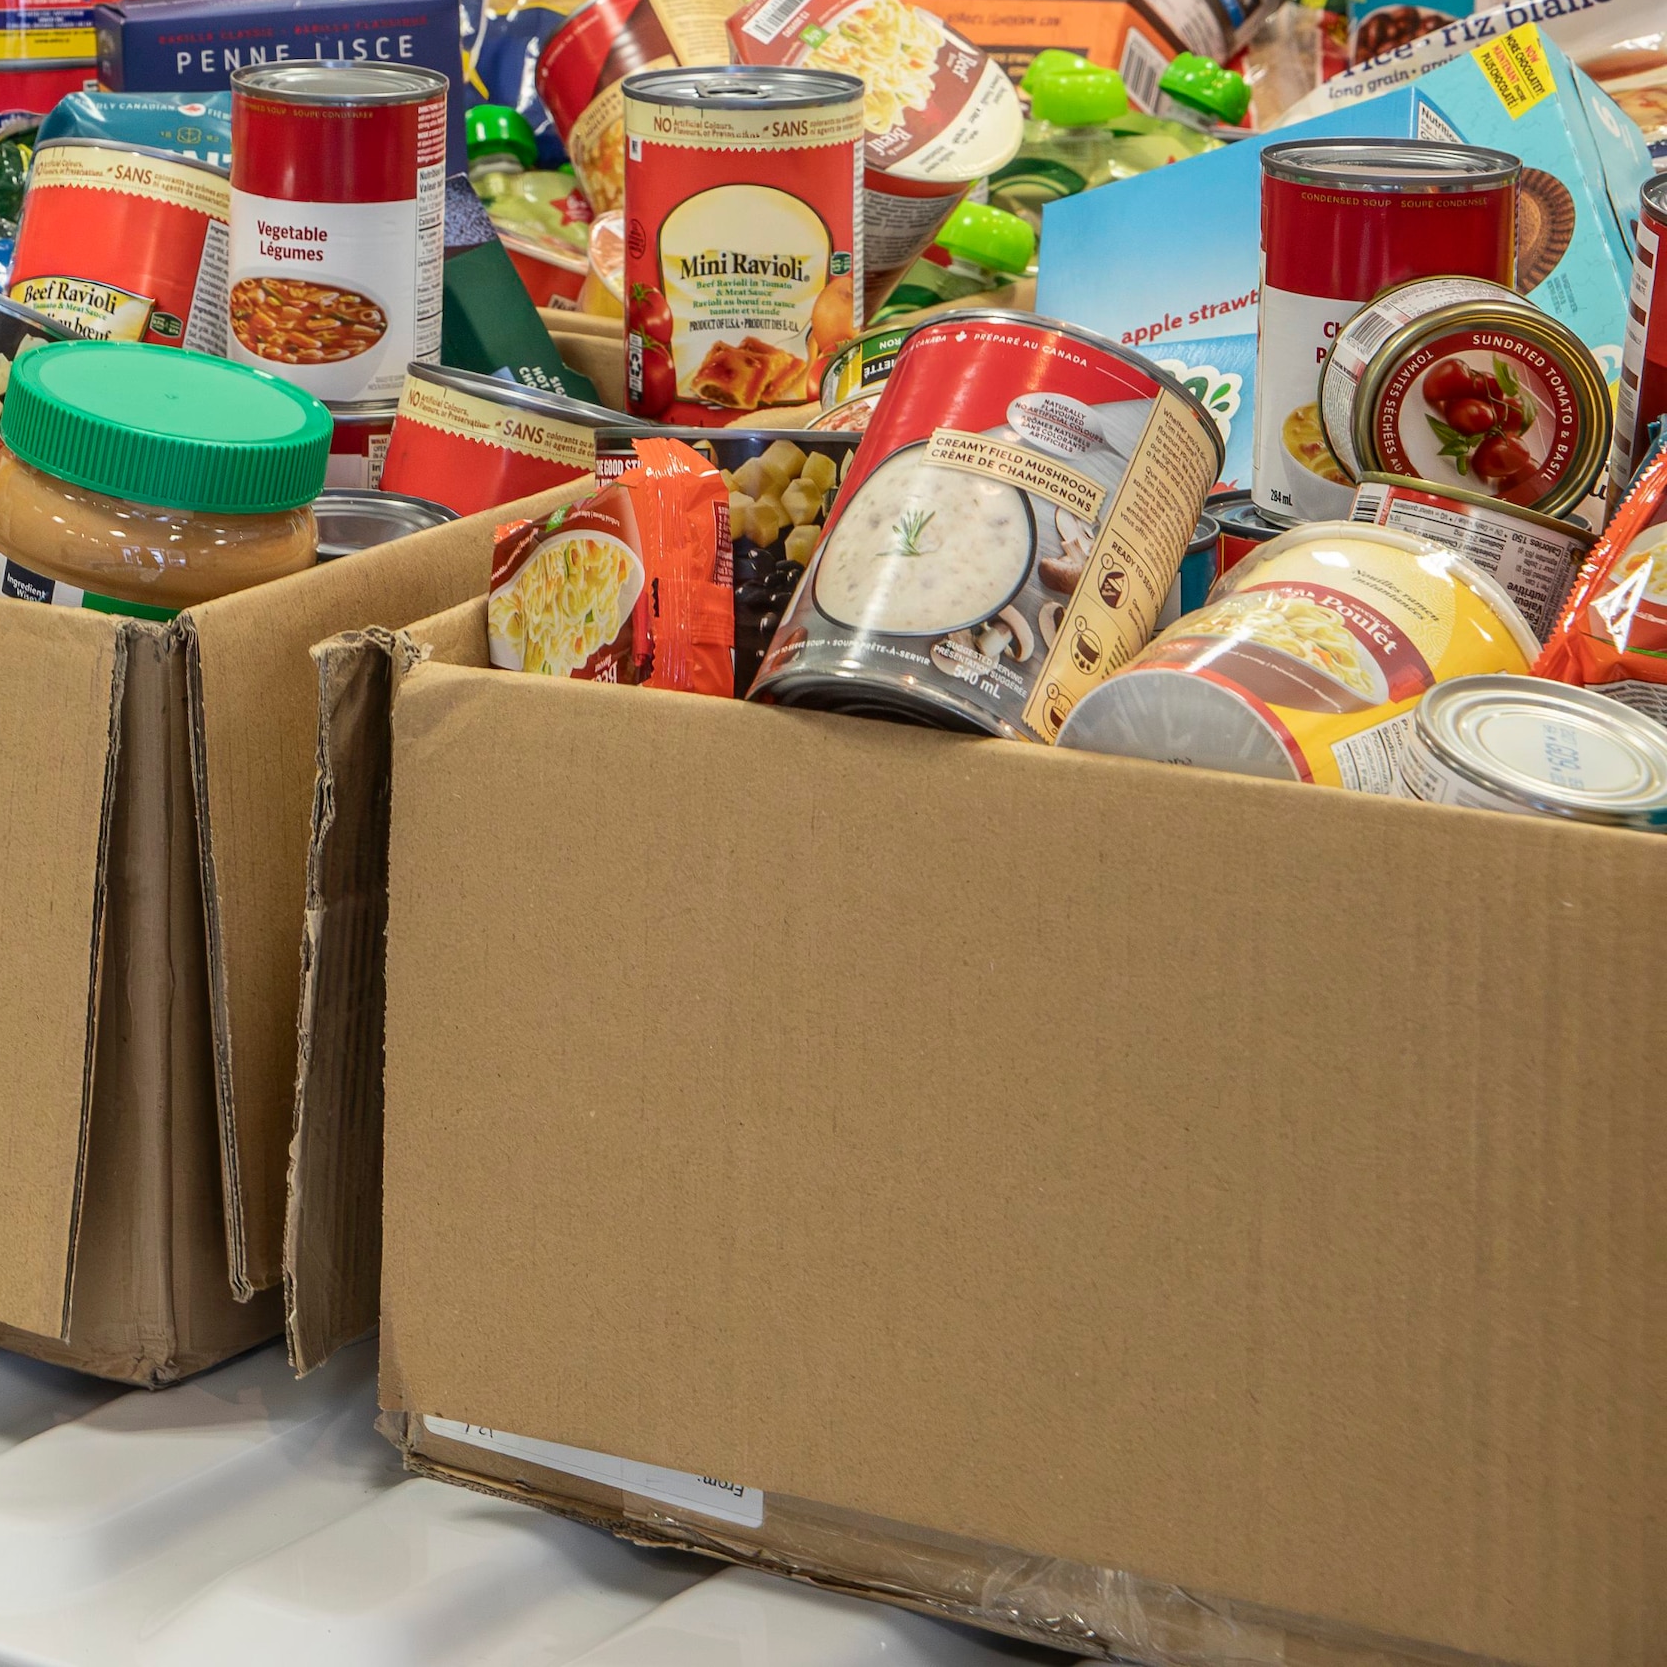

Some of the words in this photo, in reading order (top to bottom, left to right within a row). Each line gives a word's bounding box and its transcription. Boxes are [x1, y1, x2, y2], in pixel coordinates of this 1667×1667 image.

[1443, 16, 1496, 48] riz
[176, 44, 290, 75] PENNE
[314, 34, 414, 63] LISCE
[1481, 52, 1496, 70] PLUS
[1492, 44, 1520, 85] MAINTENANT
[1506, 33, 1521, 54] MORE
[1515, 52, 1546, 97] CHOCOLATEY!
[1525, 44, 1540, 64] NOW
[1328, 83, 1364, 100] long
[1366, 70, 1410, 97] grain
[653, 116, 672, 133] NO
[673, 119, 703, 129] Artificial
[772, 119, 809, 137] SANS
[115, 164, 153, 186] SANS
[1301, 191, 1360, 206] CONDENSED
[1362, 197, 1392, 208] SOUP
[1400, 198, 1434, 209] SOUPE
[257, 219, 329, 243] Vegetable
[260, 240, 325, 263] Légumes
[680, 252, 727, 280] Mini
[731, 252, 804, 282] Ravioli
[23, 279, 55, 304] Beef
[56, 280, 118, 315] Ravioli
[696, 280, 715, 290] Beef
[716, 279, 748, 288] Ravioli
[749, 279, 759, 287] in
[761, 279, 793, 290] Tomato
[748, 289, 773, 297] Sauce
[65, 303, 85, 314] Meat
[84, 306, 108, 322] Sauce
[693, 297, 722, 309] Ravioli
[724, 299, 734, 307] au
[774, 299, 796, 309] sauce
[710, 308, 740, 316] tomate
[741, 307, 750, 315] et
[752, 307, 781, 316] viande
[689, 319, 716, 332] PRODUCT
[744, 318, 771, 330] PRODUIT
[1121, 313, 1184, 347] apple
[973, 331, 1021, 346] PRÉPARÉ
[1023, 339, 1039, 351] AU
[1042, 344, 1089, 368] CANADA
[1472, 334, 1546, 368] SUNDRIED
[1389, 349, 1435, 398] TOMATES
[406, 388, 421, 408] NO
[1544, 367, 1573, 425] TOMATO
[1041, 404, 1085, 427] FLAVOURED
[1044, 398, 1087, 420] NATURALLY
[1163, 407, 1188, 434] Whether
[503, 418, 545, 445] SANS
[546, 430, 580, 446] colorants
[1014, 401, 1026, 411] NO
[1025, 405, 1069, 427] ARTIFICIAL
[1069, 422, 1104, 445] COLOURS
[1164, 420, 1177, 435] Tim
[1381, 399, 1398, 455] SÉCHÉES
[552, 440, 578, 455] agents
[1021, 422, 1043, 435] SANS
[1042, 427, 1087, 453] COLORANTS
[1028, 430, 1074, 454] ARTIFICIELS
[1053, 425, 1091, 449] NATURELS
[603, 458, 624, 477] GOOD
[936, 437, 987, 454] CREAMY
[988, 447, 1024, 465] FIELD
[1024, 459, 1097, 502] MUSHROOM
[1390, 457, 1403, 472] AU
[1540, 444, 1569, 481] BASIL
[931, 448, 974, 464] CRÈME
[977, 457, 995, 470] DE
[998, 463, 1093, 513] CHAMPIGNONS
[1270, 489, 1283, 506] 284
[1283, 492, 1293, 506] mL
[1478, 536, 1505, 551] Sodium
[1529, 536, 1562, 557] Calories
[1111, 540, 1136, 568] READY
[1135, 567, 1146, 581] TO
[7, 572, 47, 600] Ingredient
[1351, 576, 1425, 621] instantanées
[1352, 568, 1401, 593] Nouilles
[1402, 591, 1439, 623] ramen
[1507, 581, 1547, 602] nutritive
[1512, 597, 1543, 616] Valeur
[1320, 594, 1398, 656] Poulet
[933, 644, 991, 676] PRÉSENTATION
[988, 669, 1029, 699] SUGGÉRÉE
[945, 639, 994, 665] SUGGESTED
[994, 661, 1024, 683] SERVING
[953, 663, 979, 686] 540
[979, 677, 1002, 700] mL
